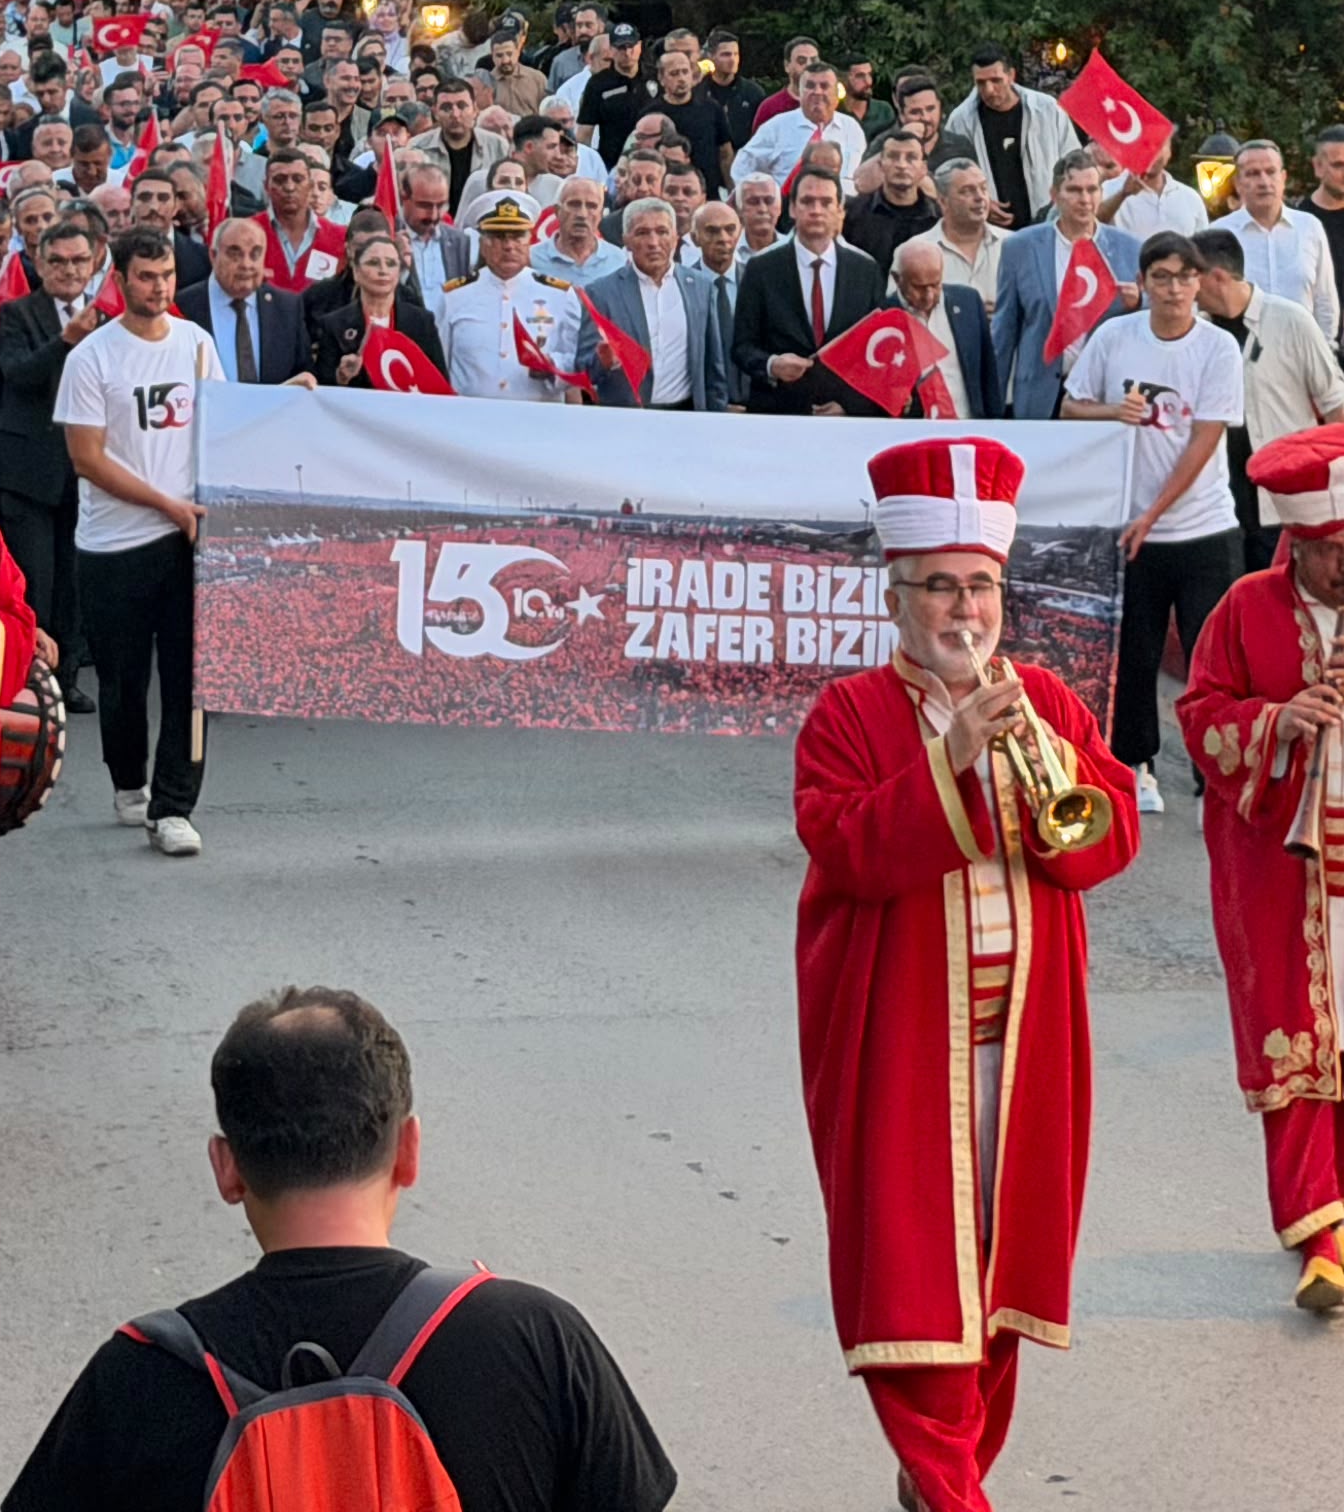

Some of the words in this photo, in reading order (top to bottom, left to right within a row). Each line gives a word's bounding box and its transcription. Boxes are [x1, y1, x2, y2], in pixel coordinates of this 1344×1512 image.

[389, 539, 538, 660] 15
[626, 558, 772, 611] İRADE
[623, 610, 774, 662] ZAFER
